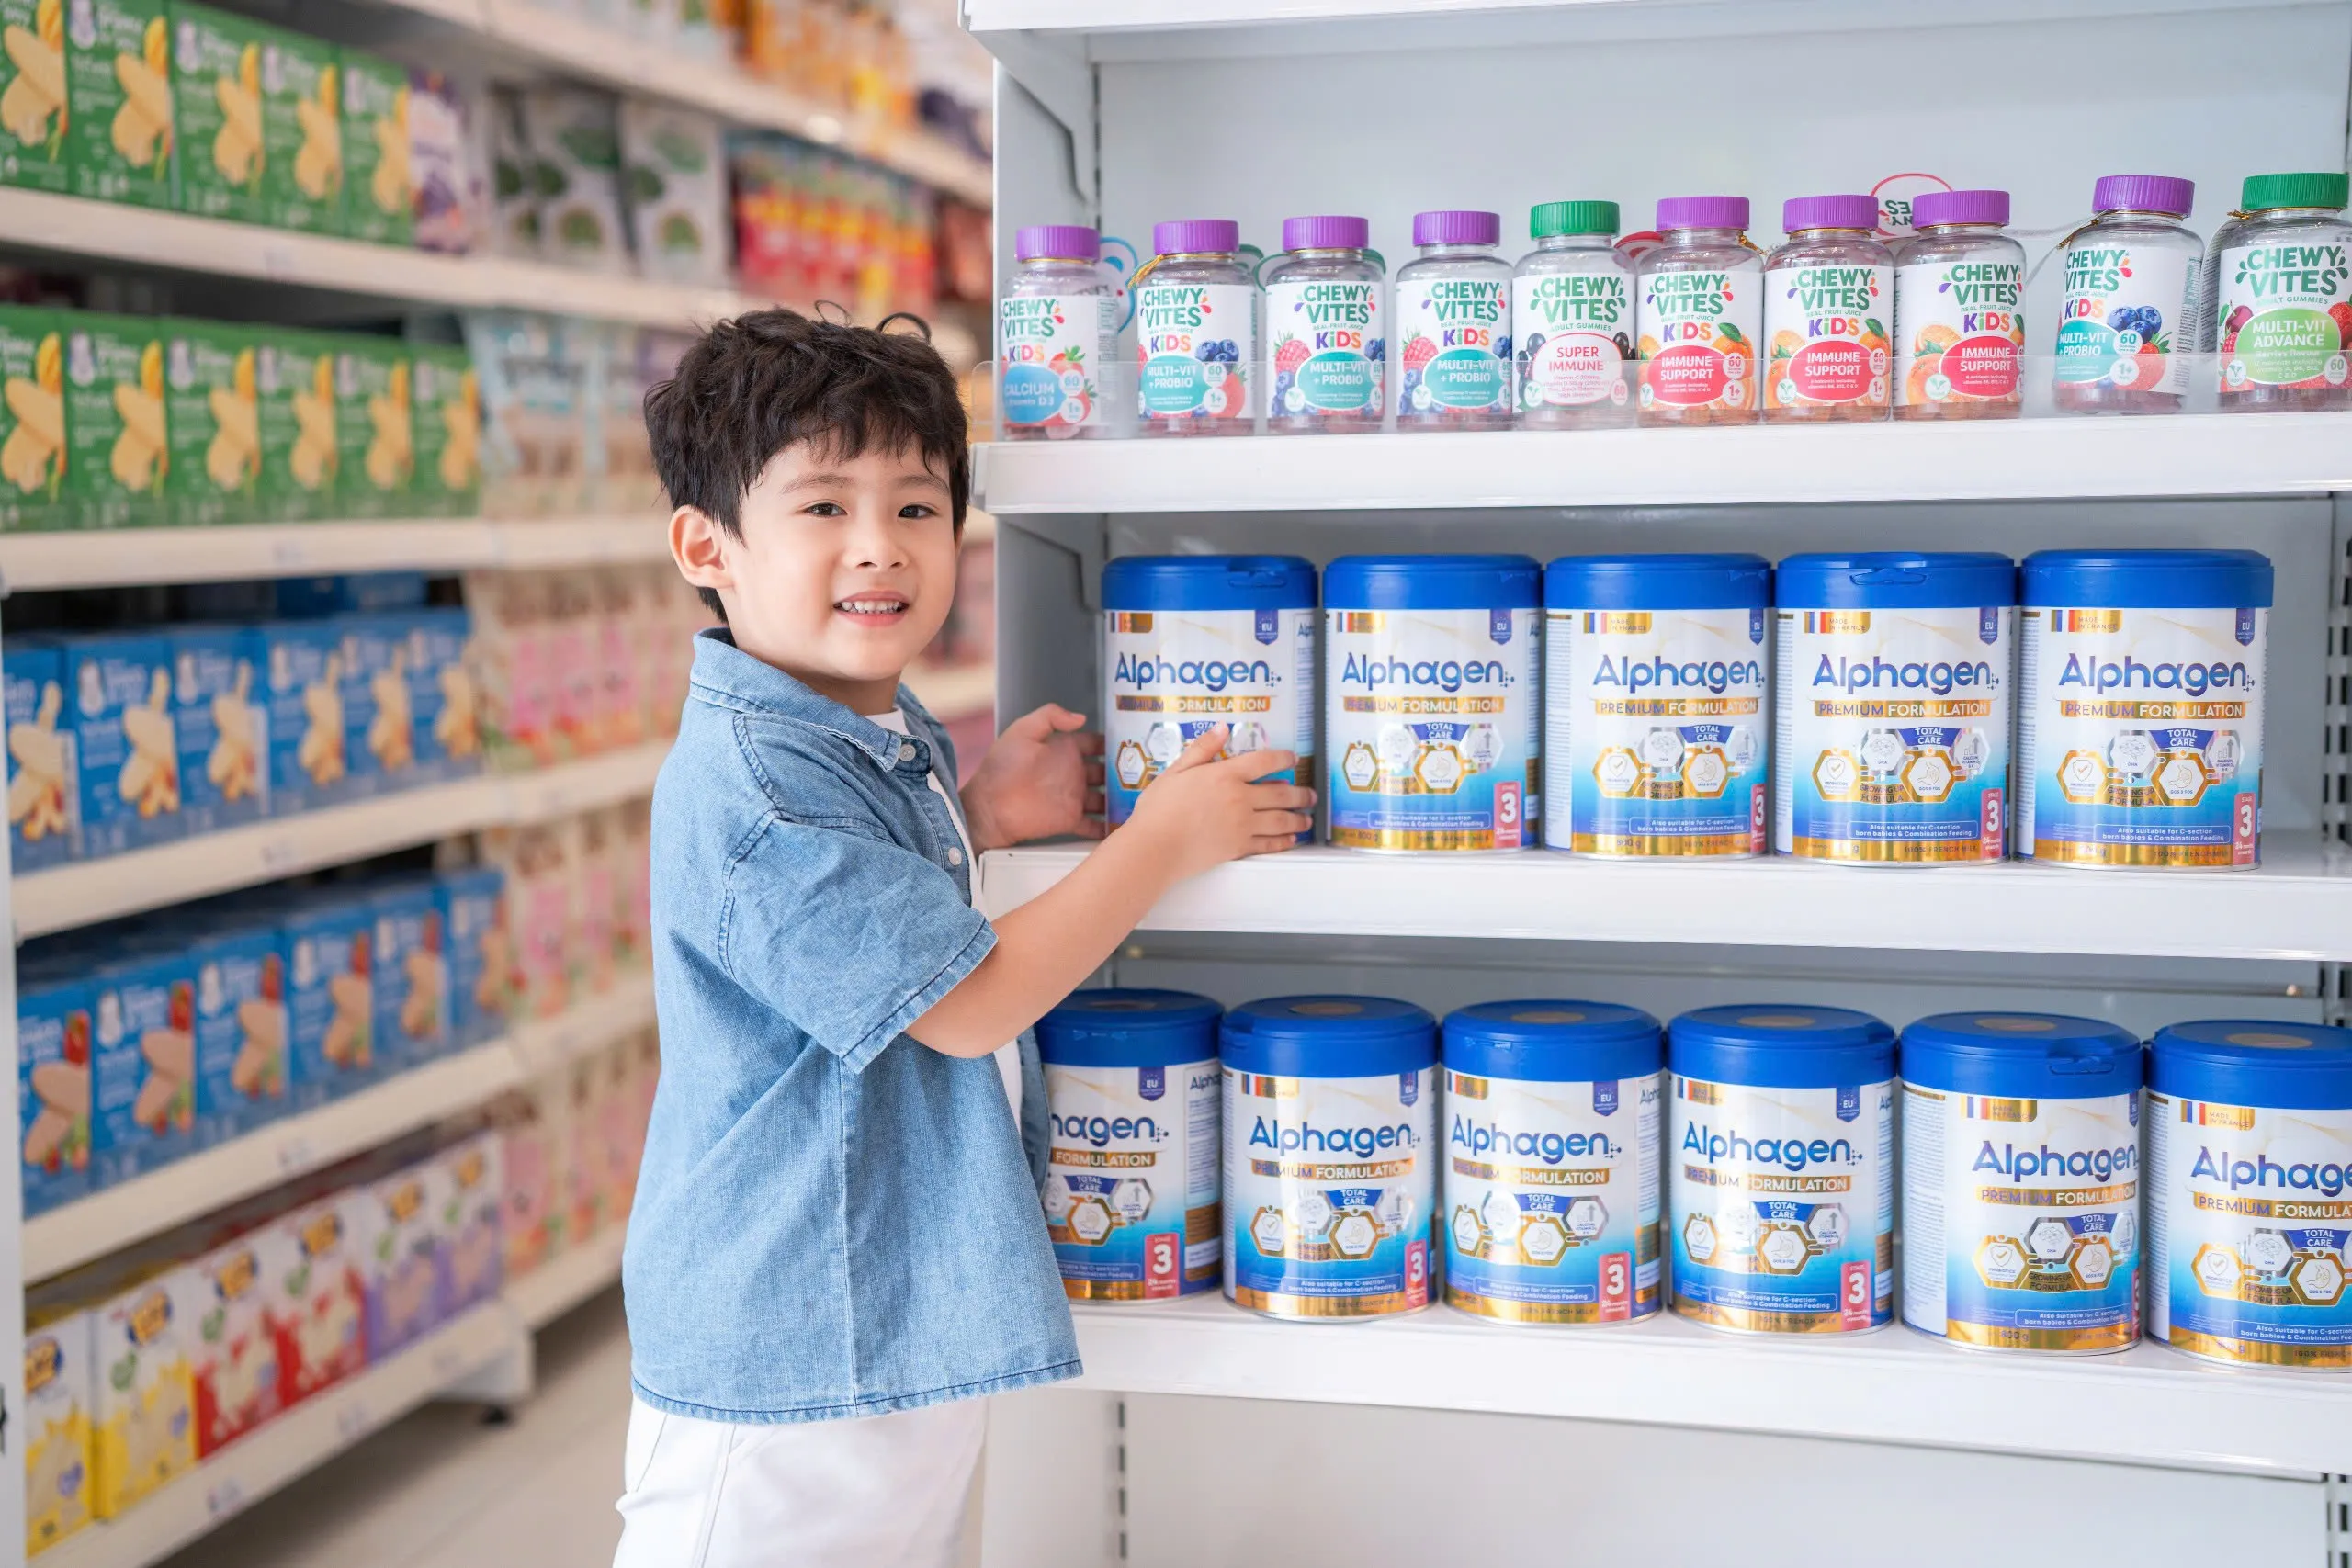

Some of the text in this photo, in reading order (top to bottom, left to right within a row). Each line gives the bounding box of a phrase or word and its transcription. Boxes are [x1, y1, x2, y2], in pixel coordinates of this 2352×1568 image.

[2067, 249, 2125, 269] CHEWY
[2247, 245, 2342, 271] CHEWY
[1797, 268, 1872, 288] CHEWY
[1951, 264, 2019, 283] CHEWY
[2065, 268, 2120, 293] VITES
[1431, 282, 1499, 299] CHEWY
[1540, 276, 1621, 298] CHEWY
[1654, 274, 1726, 294] CHEWY
[2249, 269, 2337, 298] VITES
[1144, 288, 1204, 306] CHEWY
[1304, 285, 1370, 302] CHEWY
[1799, 288, 1870, 310] VITES
[1953, 283, 2018, 306] VITES
[2286, 296, 2329, 305] GUMMIES
[1003, 299, 1056, 317] CHEWY
[1434, 300, 1498, 321] VITES
[1542, 299, 1619, 323] VITES
[1656, 292, 1724, 316] VITES
[1146, 306, 1202, 329] VITES
[1306, 303, 1369, 324] VITES
[1004, 317, 1055, 338] VITES
[1576, 322, 1611, 331] GUMMIES
[2253, 320, 2328, 334] MULTI-VIT
[2059, 332, 2108, 344] MULTI-VIT
[2120, 333, 2137, 344] 60
[2254, 333, 2325, 348] ADVANCE
[1556, 346, 1599, 358] SUPER
[1962, 347, 2011, 359] IMMUNE
[2064, 344, 2101, 356] PROBIO
[1661, 355, 1713, 367] IMMUNE
[1728, 355, 1741, 367] 60
[1807, 352, 1860, 364] IMMUNE
[2331, 359, 2344, 371] 60
[1310, 362, 1366, 373] MULTI-VIT
[1437, 360, 1494, 371] MULTI-VIT
[1548, 360, 1604, 372] IMMUNE
[1804, 365, 1861, 377] SUPPORT
[1960, 360, 2012, 372] SUPPORT
[1322, 375, 1363, 385] PROBIO
[1449, 372, 1490, 383] PROBIO
[1660, 368, 1714, 381] SUPPORT
[1155, 378, 1193, 389] PROBIO
[1261, 623, 1272, 632] EU
[1497, 623, 1507, 631] EU
[1984, 622, 1994, 630] EU
[2242, 622, 2250, 631] EU
[1114, 651, 1270, 692] Alphagen
[1342, 652, 1504, 692] Alphagen
[1593, 654, 1758, 694] Alphagen
[1813, 653, 1990, 695] Alphagen
[2058, 653, 2246, 696] Alphagen
[1165, 697, 1267, 712] ORMULATION
[1347, 697, 1499, 713] PREMIUM FORMULATION
[1600, 700, 1757, 715] PREMIUM FORMULATION
[1819, 703, 1987, 716] PREMIUM FORMULATION
[2065, 704, 2242, 717] PREMIUM FORMULATION
[1192, 721, 1219, 729] TOTA
[1426, 723, 1453, 731] TOTAL
[1694, 725, 1719, 733] TOTAL
[1915, 728, 1944, 736] TOTAL
[1429, 731, 1452, 739] CARE
[2167, 729, 2198, 738] TOTAL
[1917, 737, 1941, 745] CARE
[2170, 739, 2195, 747] CARE
[1500, 793, 1516, 824] 3
[1755, 795, 1764, 825] 3
[1986, 800, 1998, 831] 3
[2239, 805, 2252, 838] 3
[2200, 834, 2224, 842] Feeding
[1147, 1079, 1159, 1089] EU
[1250, 1115, 1411, 1158] Alphagen
[1452, 1114, 1608, 1165] Alphagen
[1683, 1121, 1850, 1171] Alphagen
[1056, 1152, 1150, 1167] FORMULATION
[1973, 1140, 2135, 1182] Alphagen
[1256, 1163, 1312, 1177] PREMIUM
[1507, 1168, 1605, 1184] RMULATION
[1077, 1176, 1102, 1184] TOTAL
[1688, 1168, 1739, 1187] PREMIUM
[1079, 1184, 1100, 1192] CARE
[1340, 1190, 1367, 1198] TOTAL
[1527, 1194, 1555, 1202] TOTAL
[1982, 1187, 2134, 1204] PREMIUM FORMULATION
[1530, 1202, 1554, 1211] CARE
[2199, 1196, 2352, 1218] PREMIUM FORMULA
[1771, 1211, 1795, 1219] CARE
[2303, 1229, 2334, 1238] TOTAL
[2307, 1239, 2333, 1247] CARE
[1152, 1244, 1172, 1275] 3
[1411, 1252, 1423, 1280] 3
[1607, 1264, 1624, 1295] 3
[2029, 1273, 2059, 1281] GROWING
[1849, 1273, 1864, 1303] 3
[2030, 1283, 2073, 1292] FORMULA
